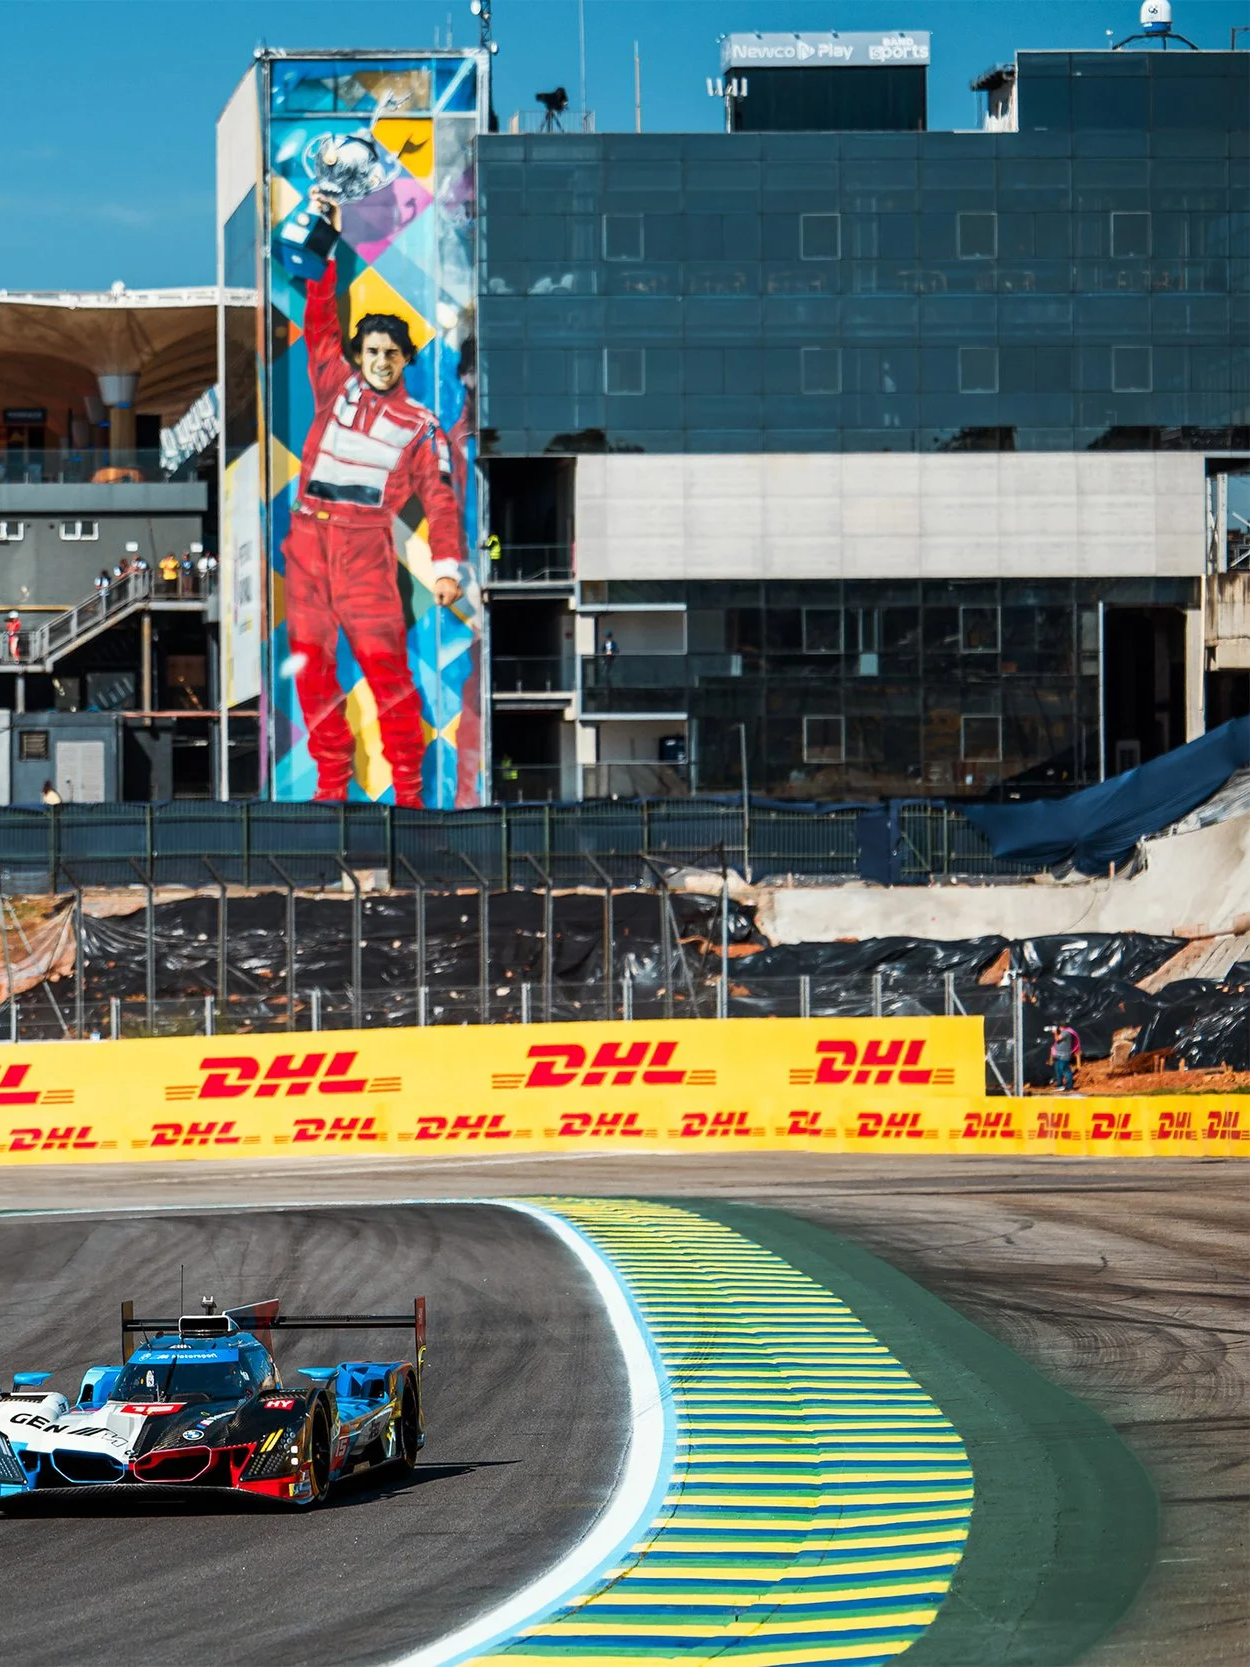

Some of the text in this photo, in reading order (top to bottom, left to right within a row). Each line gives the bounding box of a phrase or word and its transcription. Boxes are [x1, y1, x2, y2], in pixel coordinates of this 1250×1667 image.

[732, 43, 854, 60] Newco Play
[525, 1041, 686, 1087] DHL
[815, 1040, 933, 1084] DHL
[198, 1051, 367, 1099] DHL
[151, 1121, 239, 1146] DHL
[293, 1117, 377, 1142] DHL
[415, 1115, 511, 1140] DHL
[559, 1113, 643, 1136] DHL
[681, 1112, 750, 1137] DHL
[857, 1112, 924, 1138] DHL
[962, 1112, 1015, 1138] DHL
[9, 1126, 97, 1151] DHL
[266, 1400, 291, 1409] HY
[10, 1413, 69, 1433] GEN
